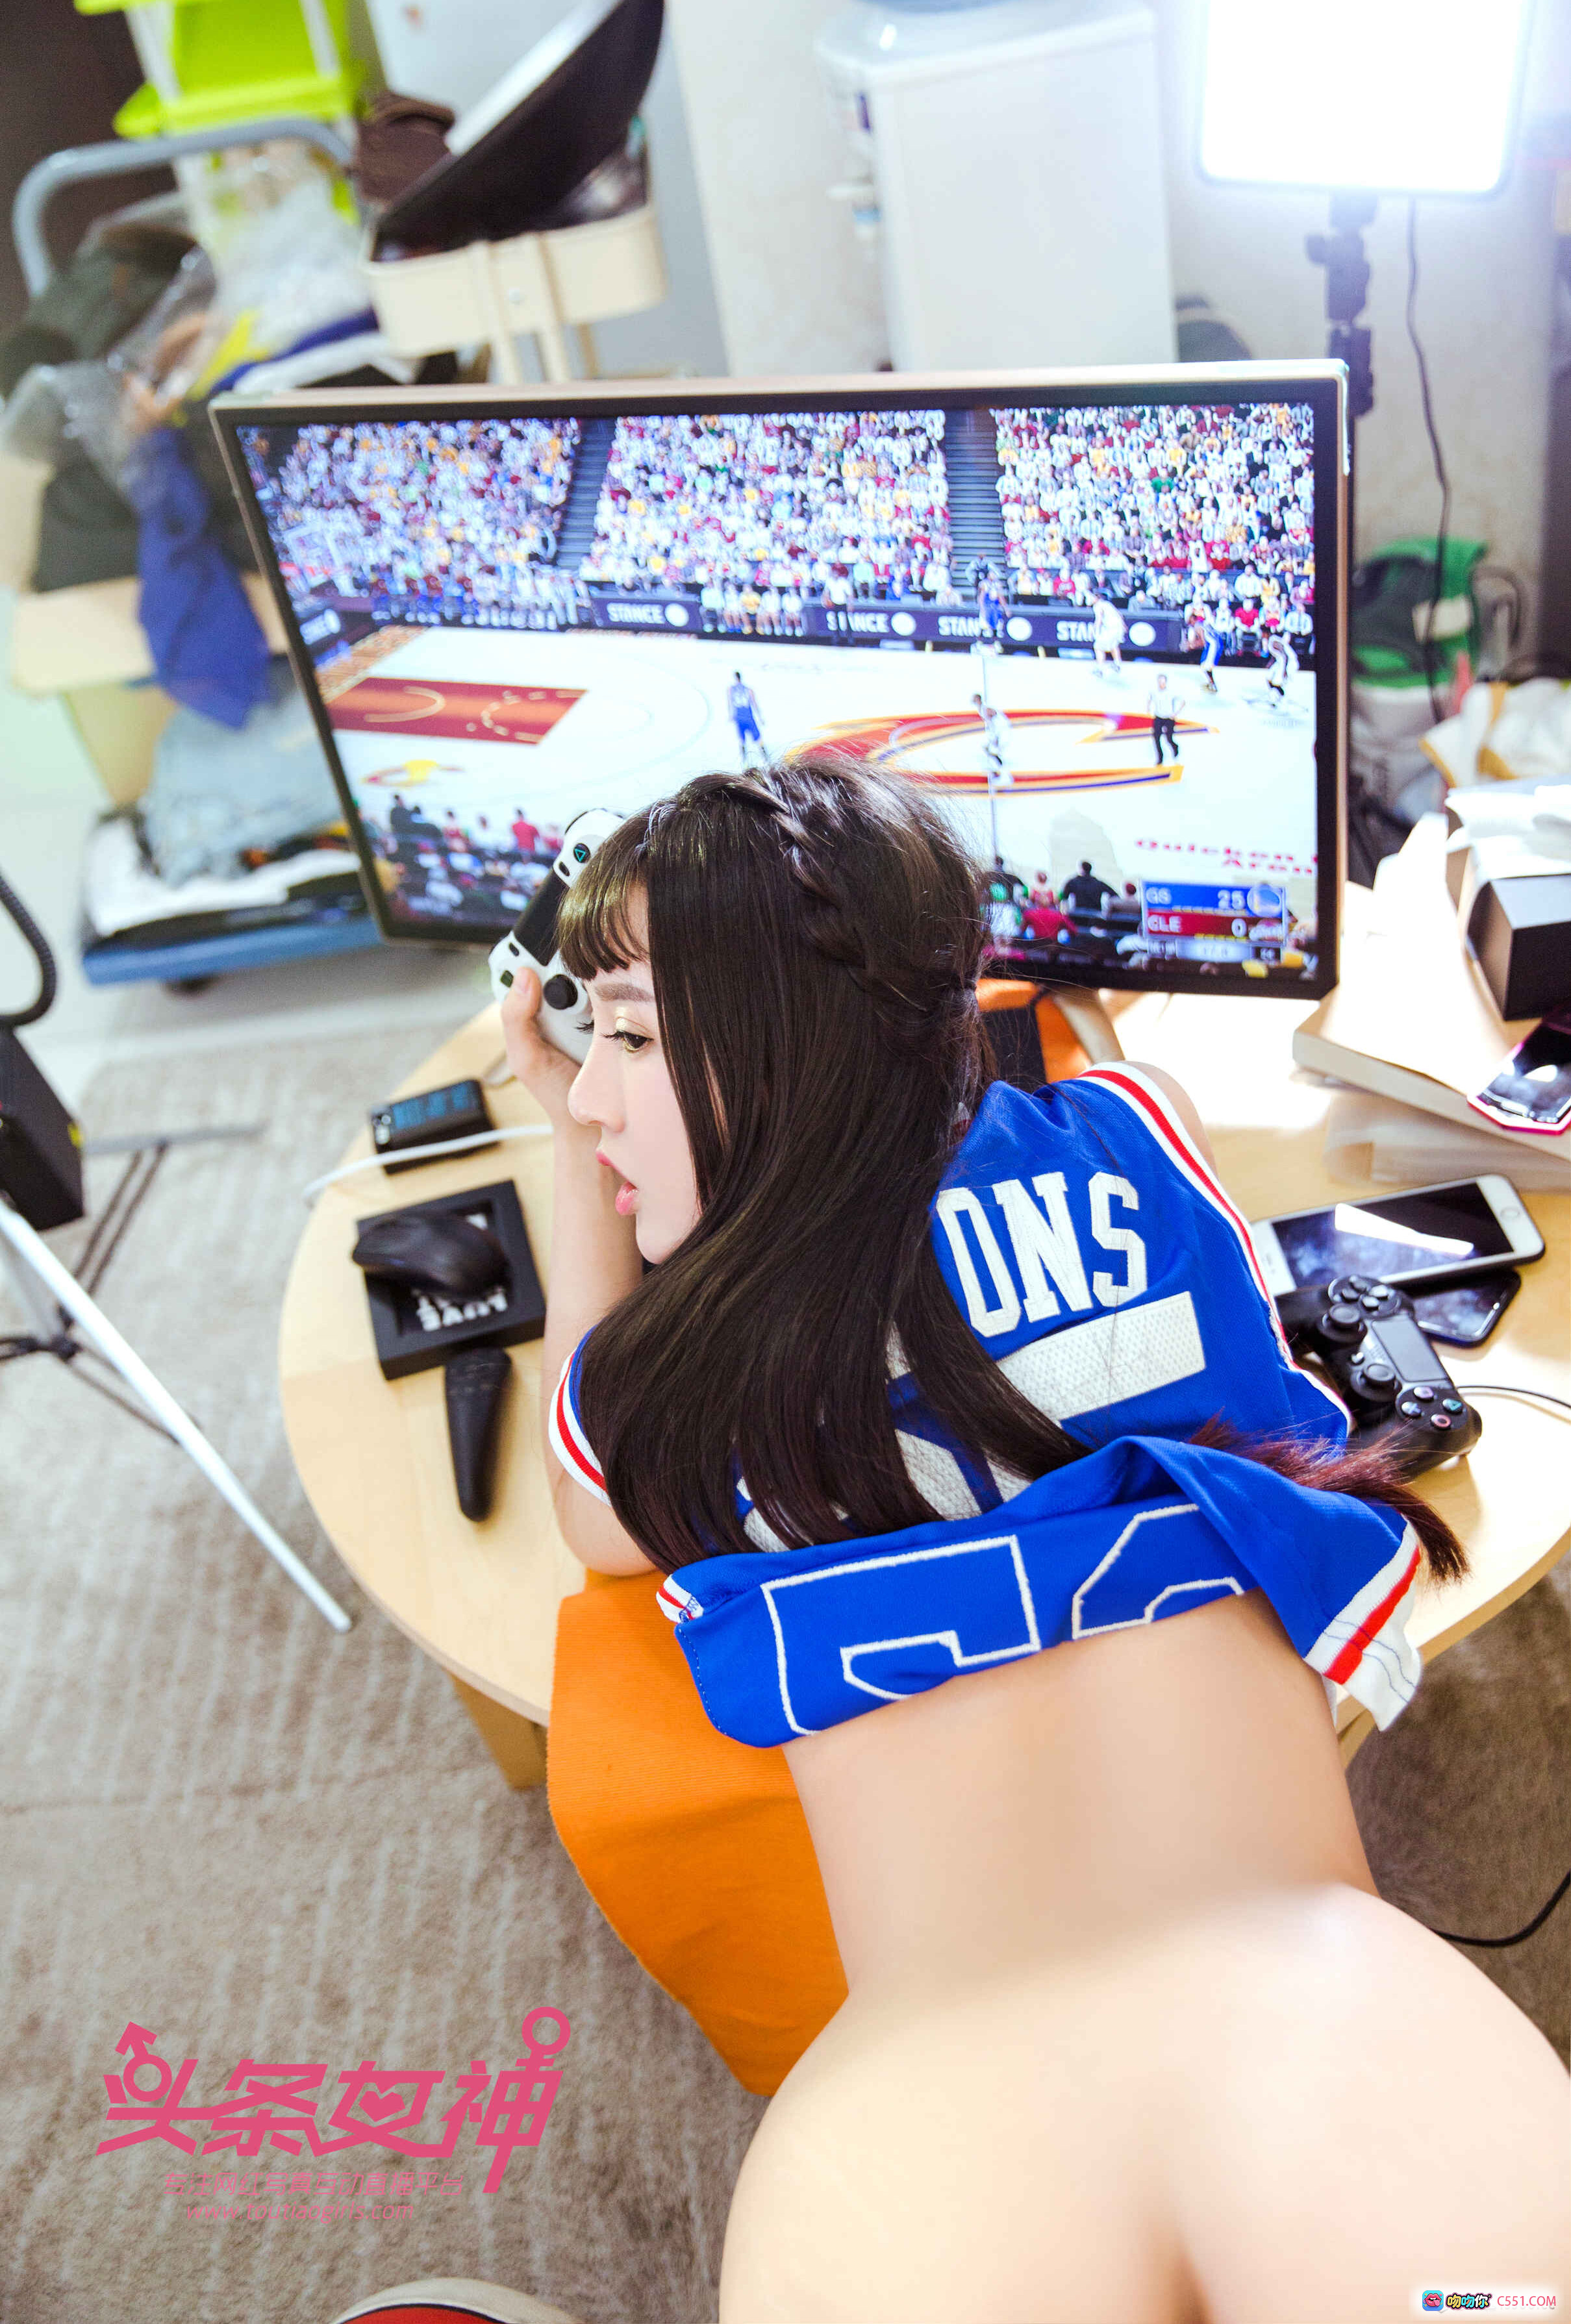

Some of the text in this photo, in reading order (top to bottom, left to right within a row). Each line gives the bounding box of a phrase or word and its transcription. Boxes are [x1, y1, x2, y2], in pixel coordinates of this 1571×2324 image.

[607, 602, 666, 624] STANCE
[938, 616, 1004, 638] STAN
[1057, 621, 1096, 642] STAN
[1146, 887, 1245, 909] GS 25
[1148, 914, 1247, 937] CLE 0
[936, 1171, 1147, 1338] ONS
